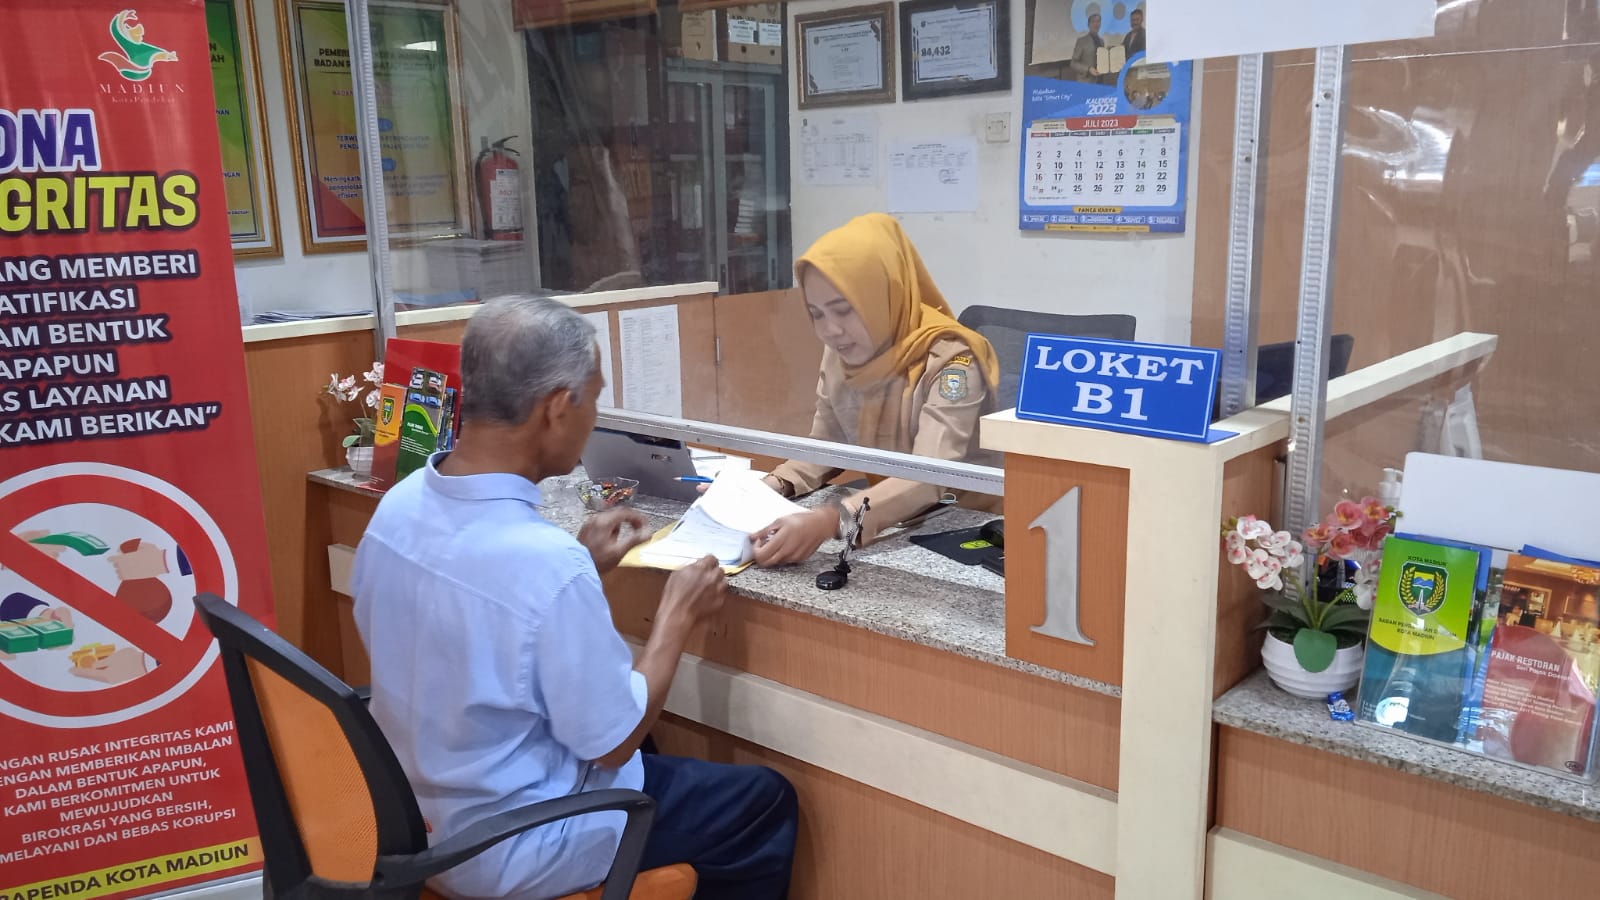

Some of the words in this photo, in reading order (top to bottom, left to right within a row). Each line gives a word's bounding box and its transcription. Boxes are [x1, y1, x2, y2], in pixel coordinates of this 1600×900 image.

[1083, 119, 1099, 128] JULI
[1101, 119, 1119, 128] 2023
[1087, 104, 1117, 115] 2023
[1036, 162, 1042, 170] 9
[1054, 161, 1063, 169] 10
[1074, 161, 1083, 169] 11
[1095, 161, 1104, 169] 12
[1116, 160, 1125, 169] 13
[1137, 160, 1146, 169] 14
[1158, 160, 1168, 168] 15
[1056, 150, 1062, 158] 3
[1076, 150, 1082, 158] 4
[1118, 149, 1124, 157] 6
[1139, 148, 1145, 156] 7
[1160, 147, 1167, 156] 8
[1035, 173, 1043, 181] 16
[1054, 173, 1063, 181] 17
[1074, 173, 1083, 181] 18
[1095, 173, 1104, 181] 19
[1114, 172, 1125, 180] 20
[1136, 172, 1145, 180] 21
[1157, 172, 1167, 180] 22
[1093, 184, 1103, 192] 26
[1114, 184, 1124, 193] 27
[1135, 184, 1145, 192] 28
[1156, 184, 1167, 193] 29
[0, 259, 51, 282] NG
[60, 254, 196, 279] MEMBERI
[0, 288, 136, 315] ATIFIKASI
[50, 318, 168, 344] BENTUK
[0, 353, 115, 380] APAPUN
[1034, 345, 1205, 385] LOKET
[0, 391, 21, 412] S
[29, 379, 168, 409] LAYANAN
[1072, 381, 1148, 421] B1
[0, 418, 73, 443] KAMI
[1027, 485, 1097, 647] 1
[1491, 649, 1516, 663] PAJAK
[1517, 655, 1560, 672] RESTORAN
[49, 744, 101, 763] RUSAK
[105, 730, 192, 752] INTEGRITAS
[195, 720, 234, 738] KAMI
[56, 749, 161, 776] MEMBERIKAN
[165, 736, 233, 757] IMBALAN
[4, 800, 47, 817] KAMI
[51, 778, 165, 809] BERKOMITMEN
[169, 768, 220, 786] UNTUK
[15, 780, 72, 799] DALAM
[77, 768, 138, 788] BENTUK
[142, 757, 207, 775] APAPUN,
[60, 791, 173, 822] MEWUJUDKAN
[0, 833, 80, 864] MELAYANI
[84, 832, 118, 848] DAN
[122, 822, 169, 840] BEBAS
[173, 808, 236, 829] KORUPSI
[22, 819, 106, 844] BIROKRASI
[110, 809, 152, 825] YANG
[156, 800, 213, 817] BERSIH,
[106, 864, 160, 885] KOTA
[166, 843, 249, 873] MADIUN
